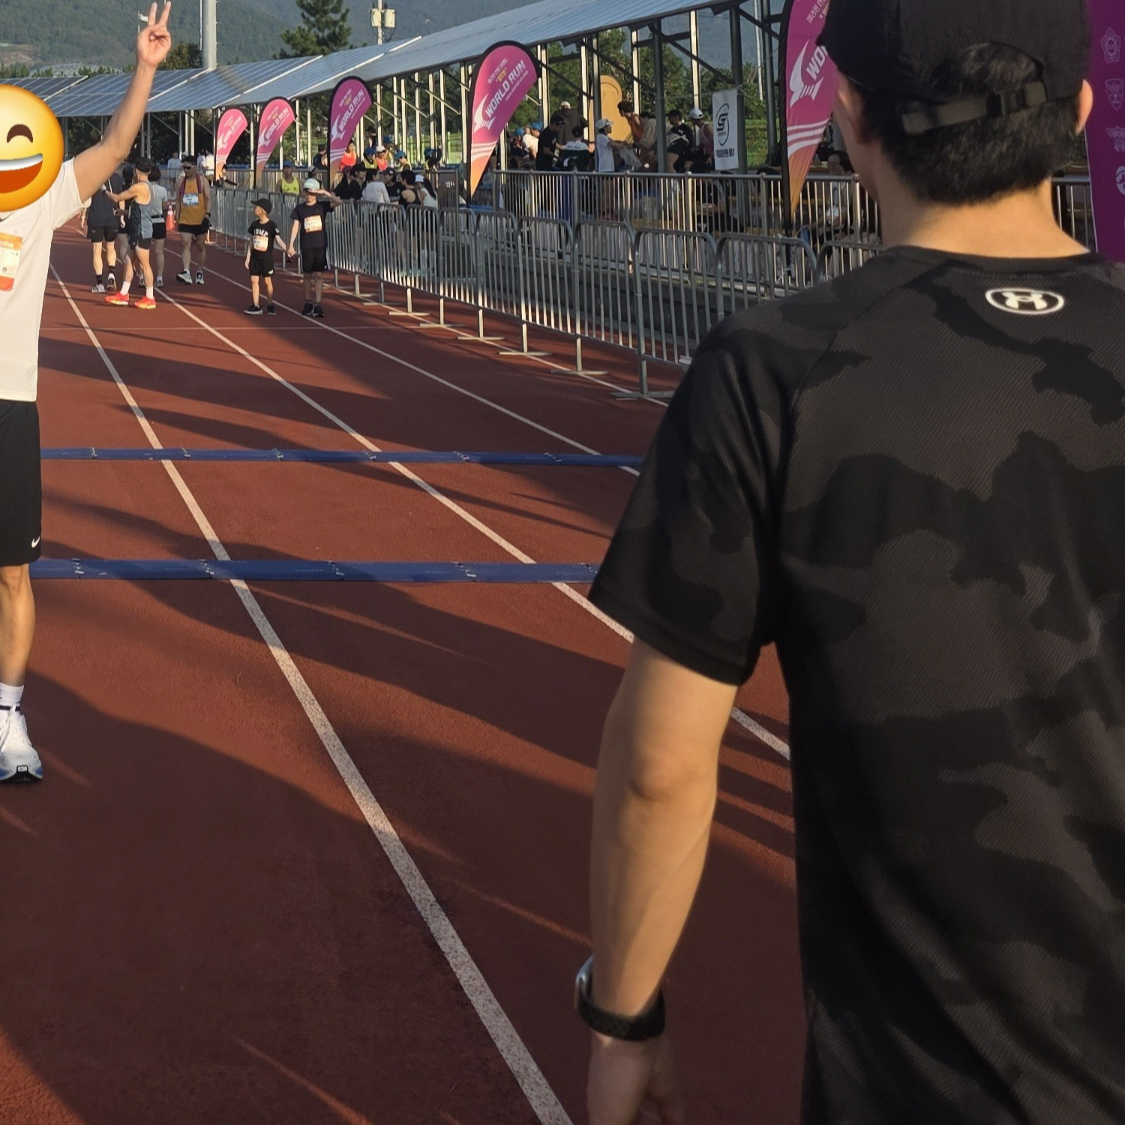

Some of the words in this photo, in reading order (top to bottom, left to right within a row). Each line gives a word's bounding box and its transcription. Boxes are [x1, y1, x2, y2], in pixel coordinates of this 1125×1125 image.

[485, 80, 510, 118] WORLD
[508, 59, 526, 84] RUN
[338, 103, 355, 132] WORLD
